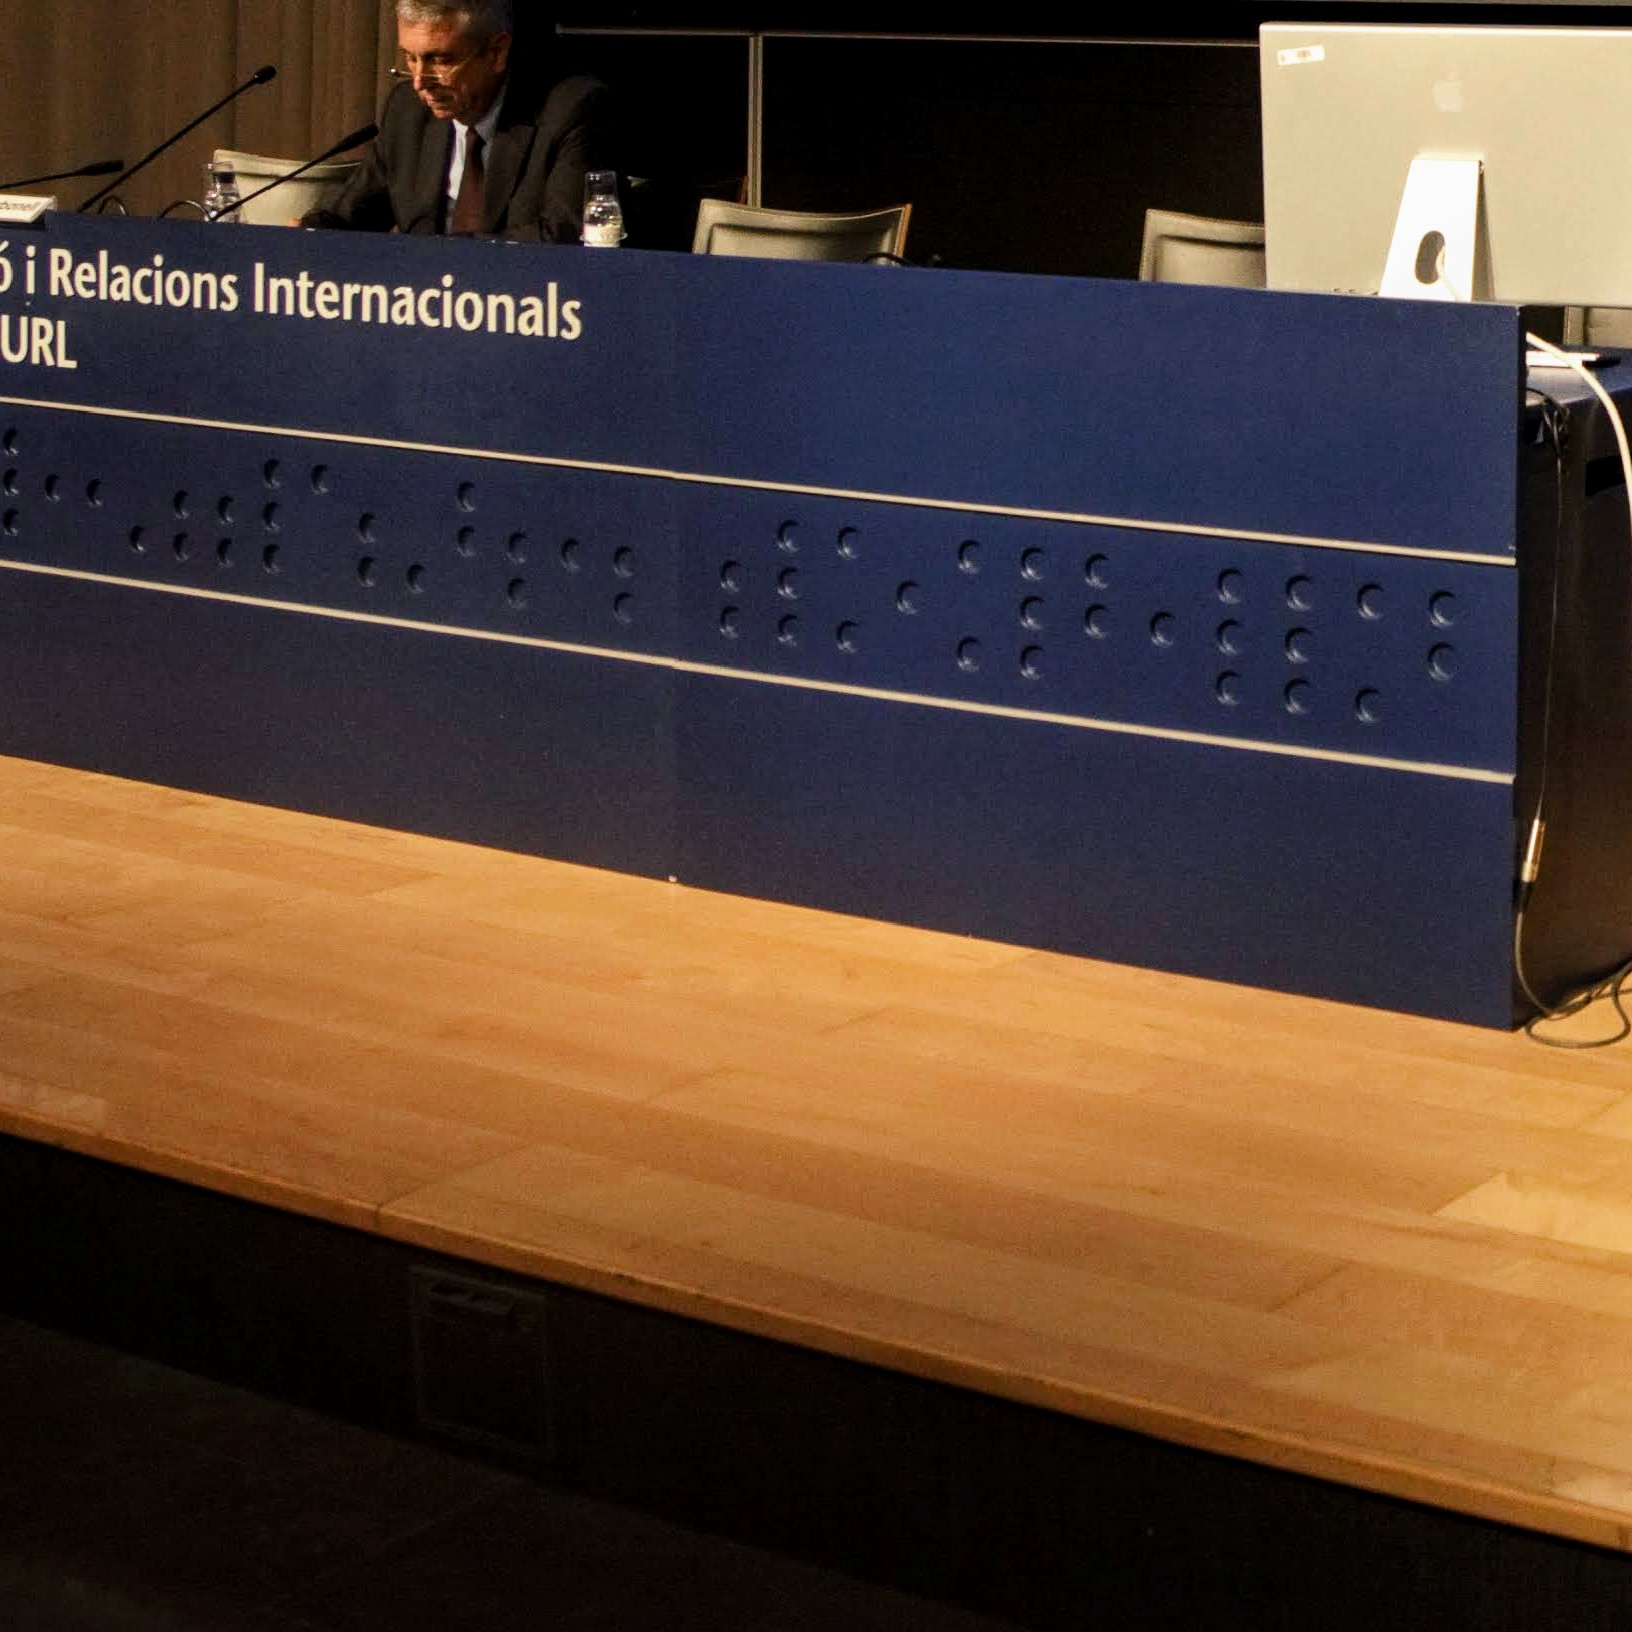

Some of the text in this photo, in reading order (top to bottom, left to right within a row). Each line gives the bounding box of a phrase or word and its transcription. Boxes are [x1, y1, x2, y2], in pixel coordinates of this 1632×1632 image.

[26, 245, 36, 294] i
[50, 248, 240, 313] Relacions
[253, 262, 583, 341] Internacionals
[0, 314, 78, 369] URL
